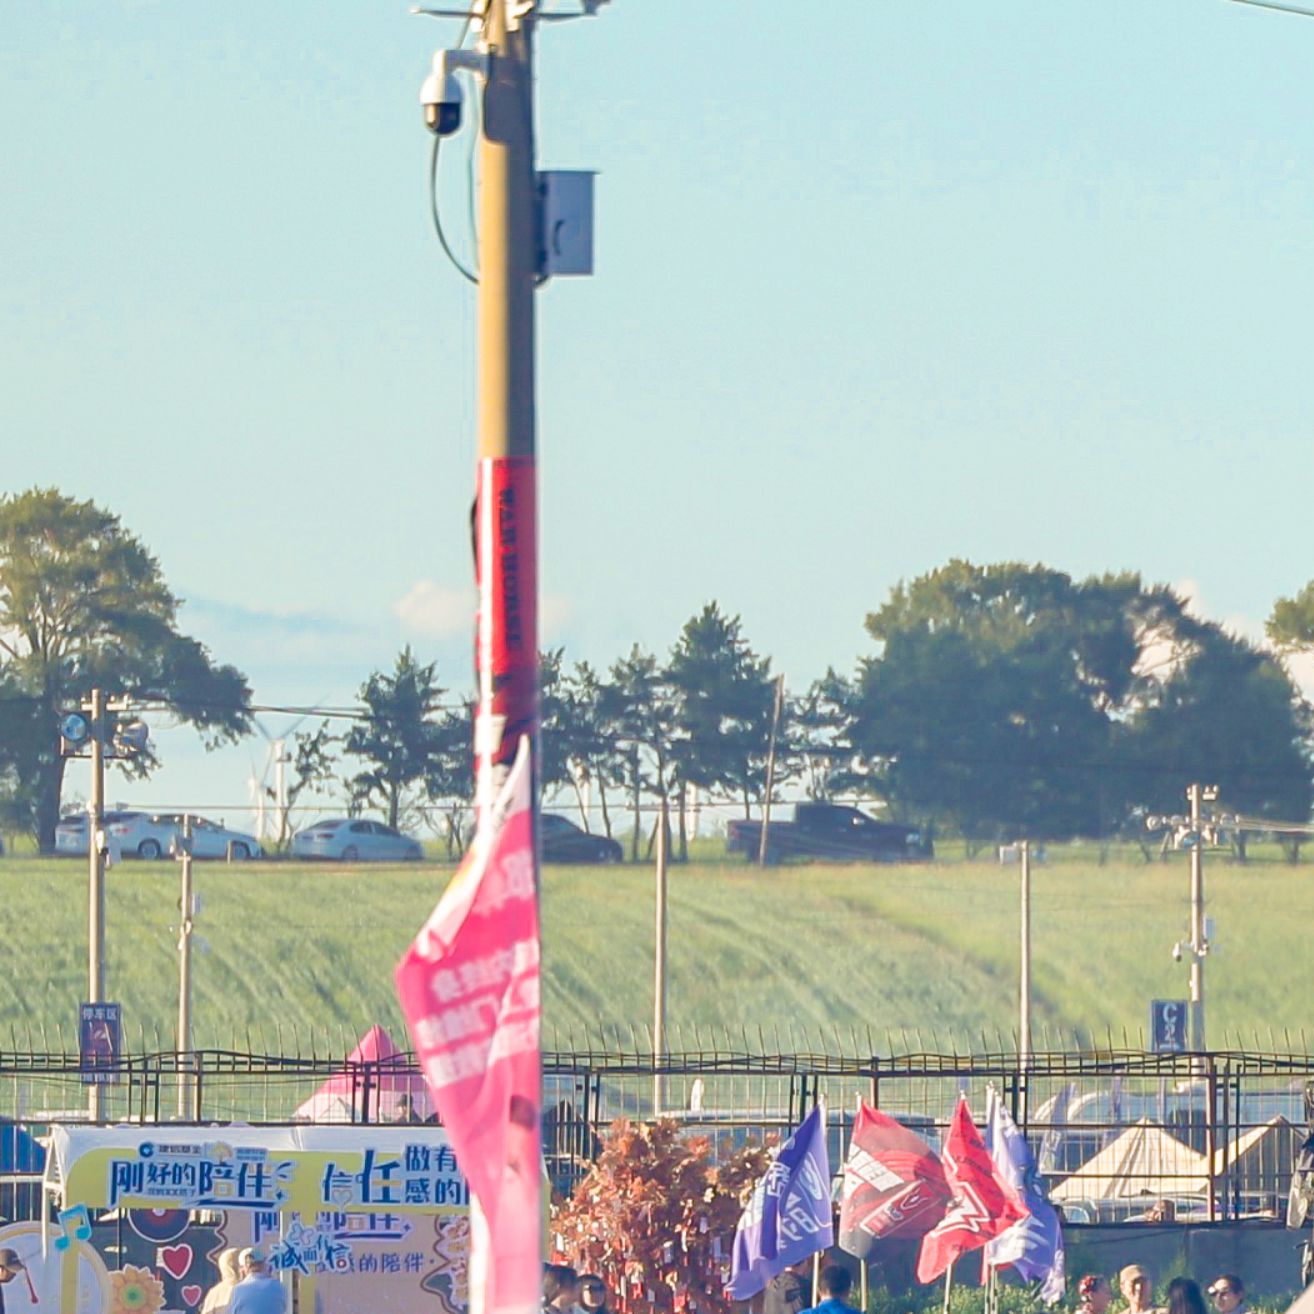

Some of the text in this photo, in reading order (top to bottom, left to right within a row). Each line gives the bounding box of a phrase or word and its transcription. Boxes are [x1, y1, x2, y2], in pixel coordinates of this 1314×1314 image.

[110, 1160, 272, 1206] 刚好的陪伴
[322, 1149, 401, 1204] 信任
[405, 1178, 471, 1205] 感的
